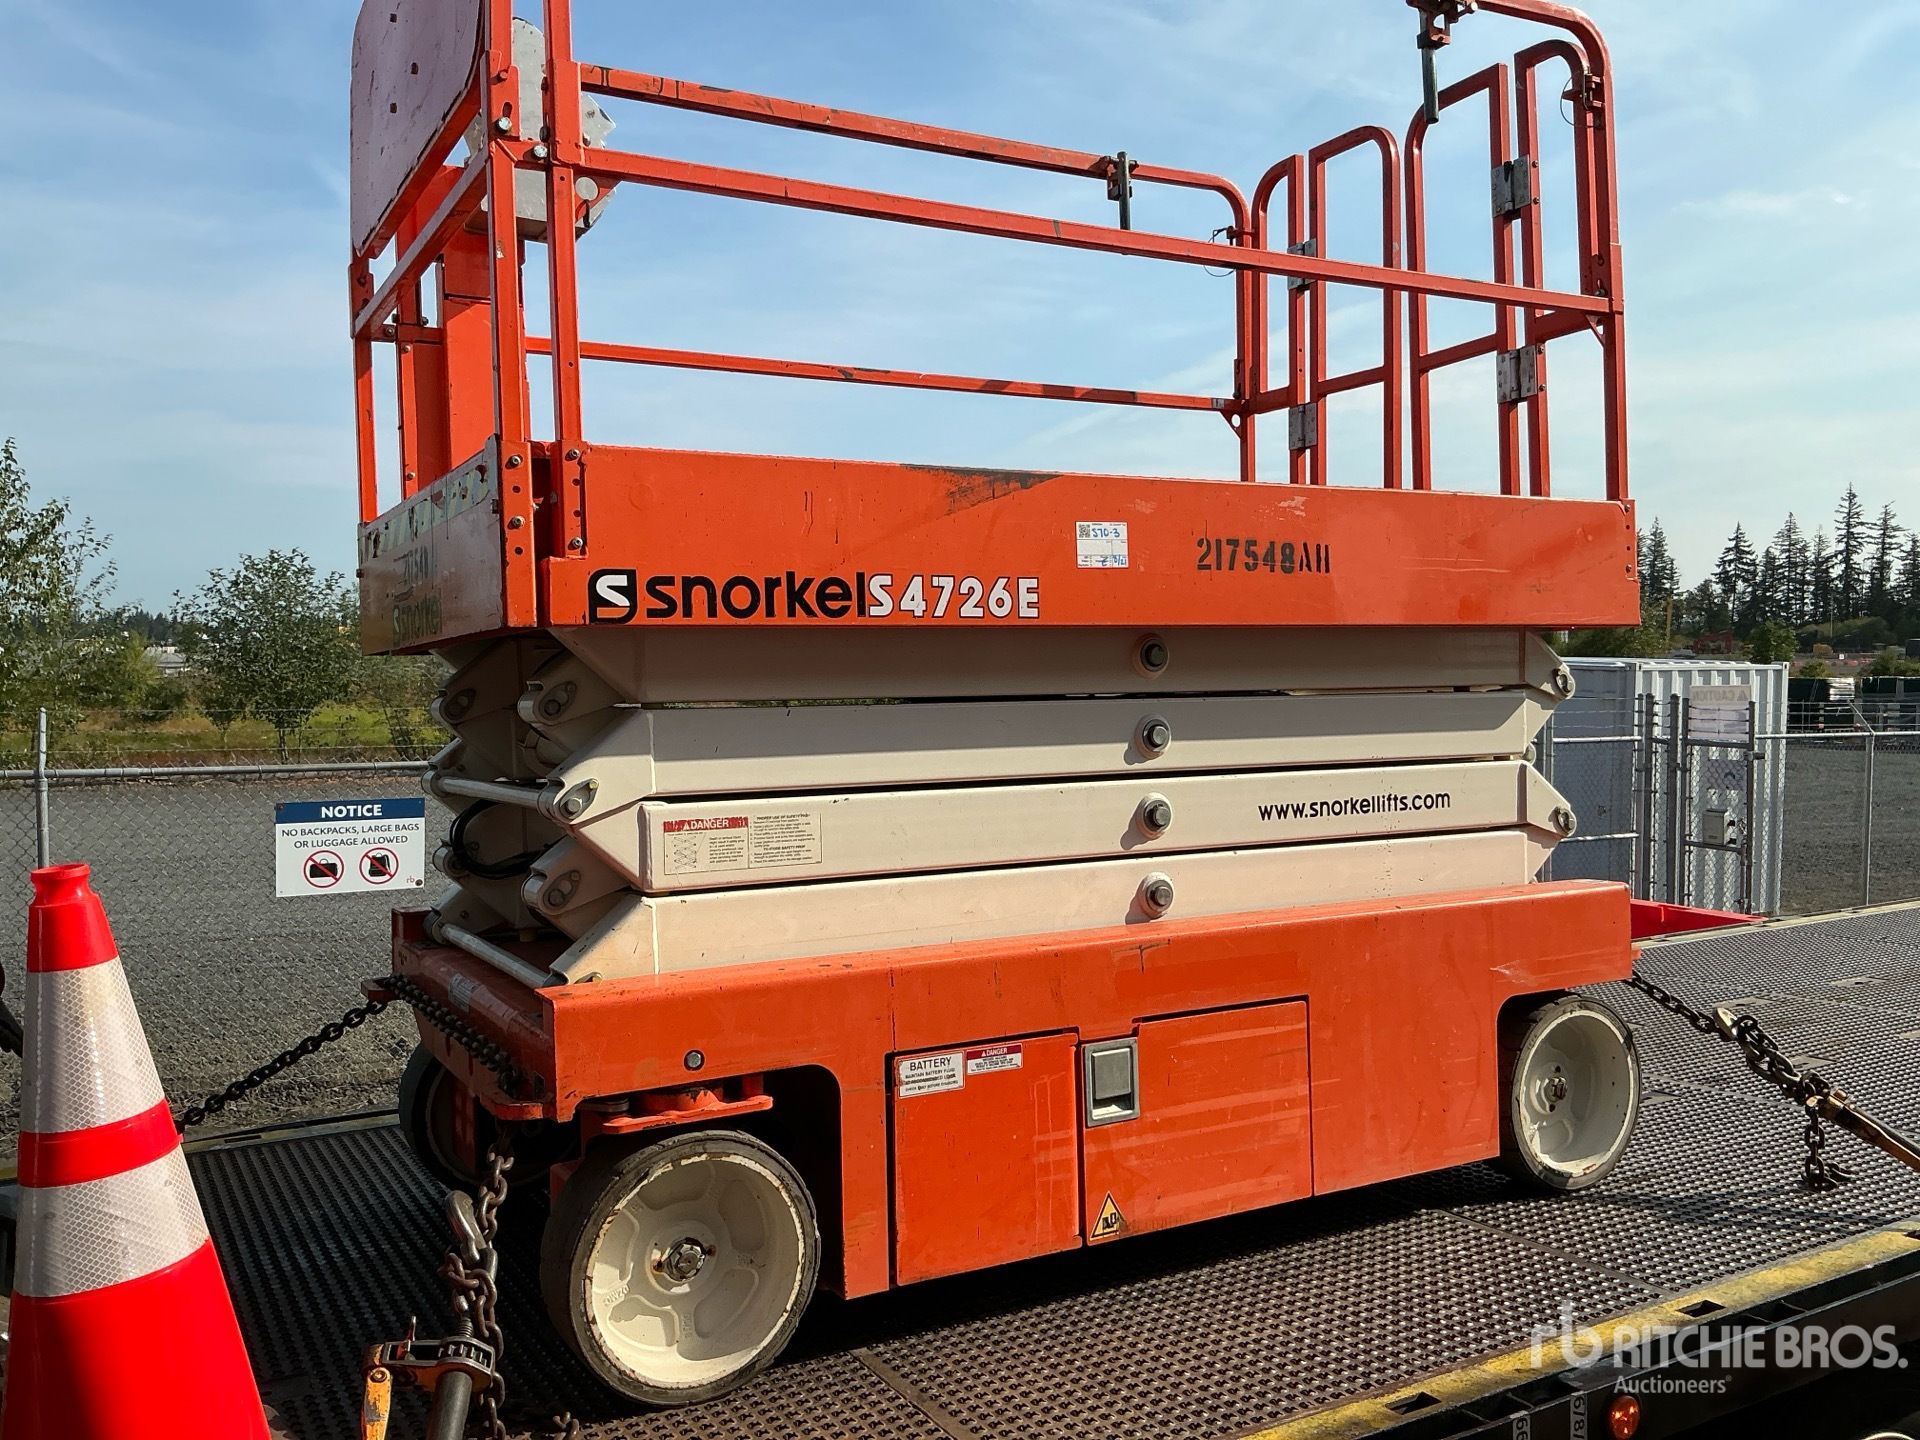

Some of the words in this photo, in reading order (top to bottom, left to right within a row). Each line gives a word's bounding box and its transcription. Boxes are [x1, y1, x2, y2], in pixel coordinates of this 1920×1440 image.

[645, 571, 865, 619] snorkel
[868, 574, 1039, 618] S4726E
[321, 804, 382, 818] NOTICE
[1258, 792, 1451, 821] www.snorkellifts.com
[282, 829, 298, 837] NO
[300, 826, 359, 836] BACKPACKS,
[361, 823, 392, 833] LARGE
[395, 823, 420, 831] BAGS
[691, 819, 729, 830] DANGER
[294, 840, 309, 849] OR
[311, 838, 358, 848] LUGGAGE
[360, 835, 408, 845] ALLOWED
[406, 876, 415, 884] rb
[986, 1047, 1008, 1057] DANGER
[910, 1056, 951, 1071] BATTERY
